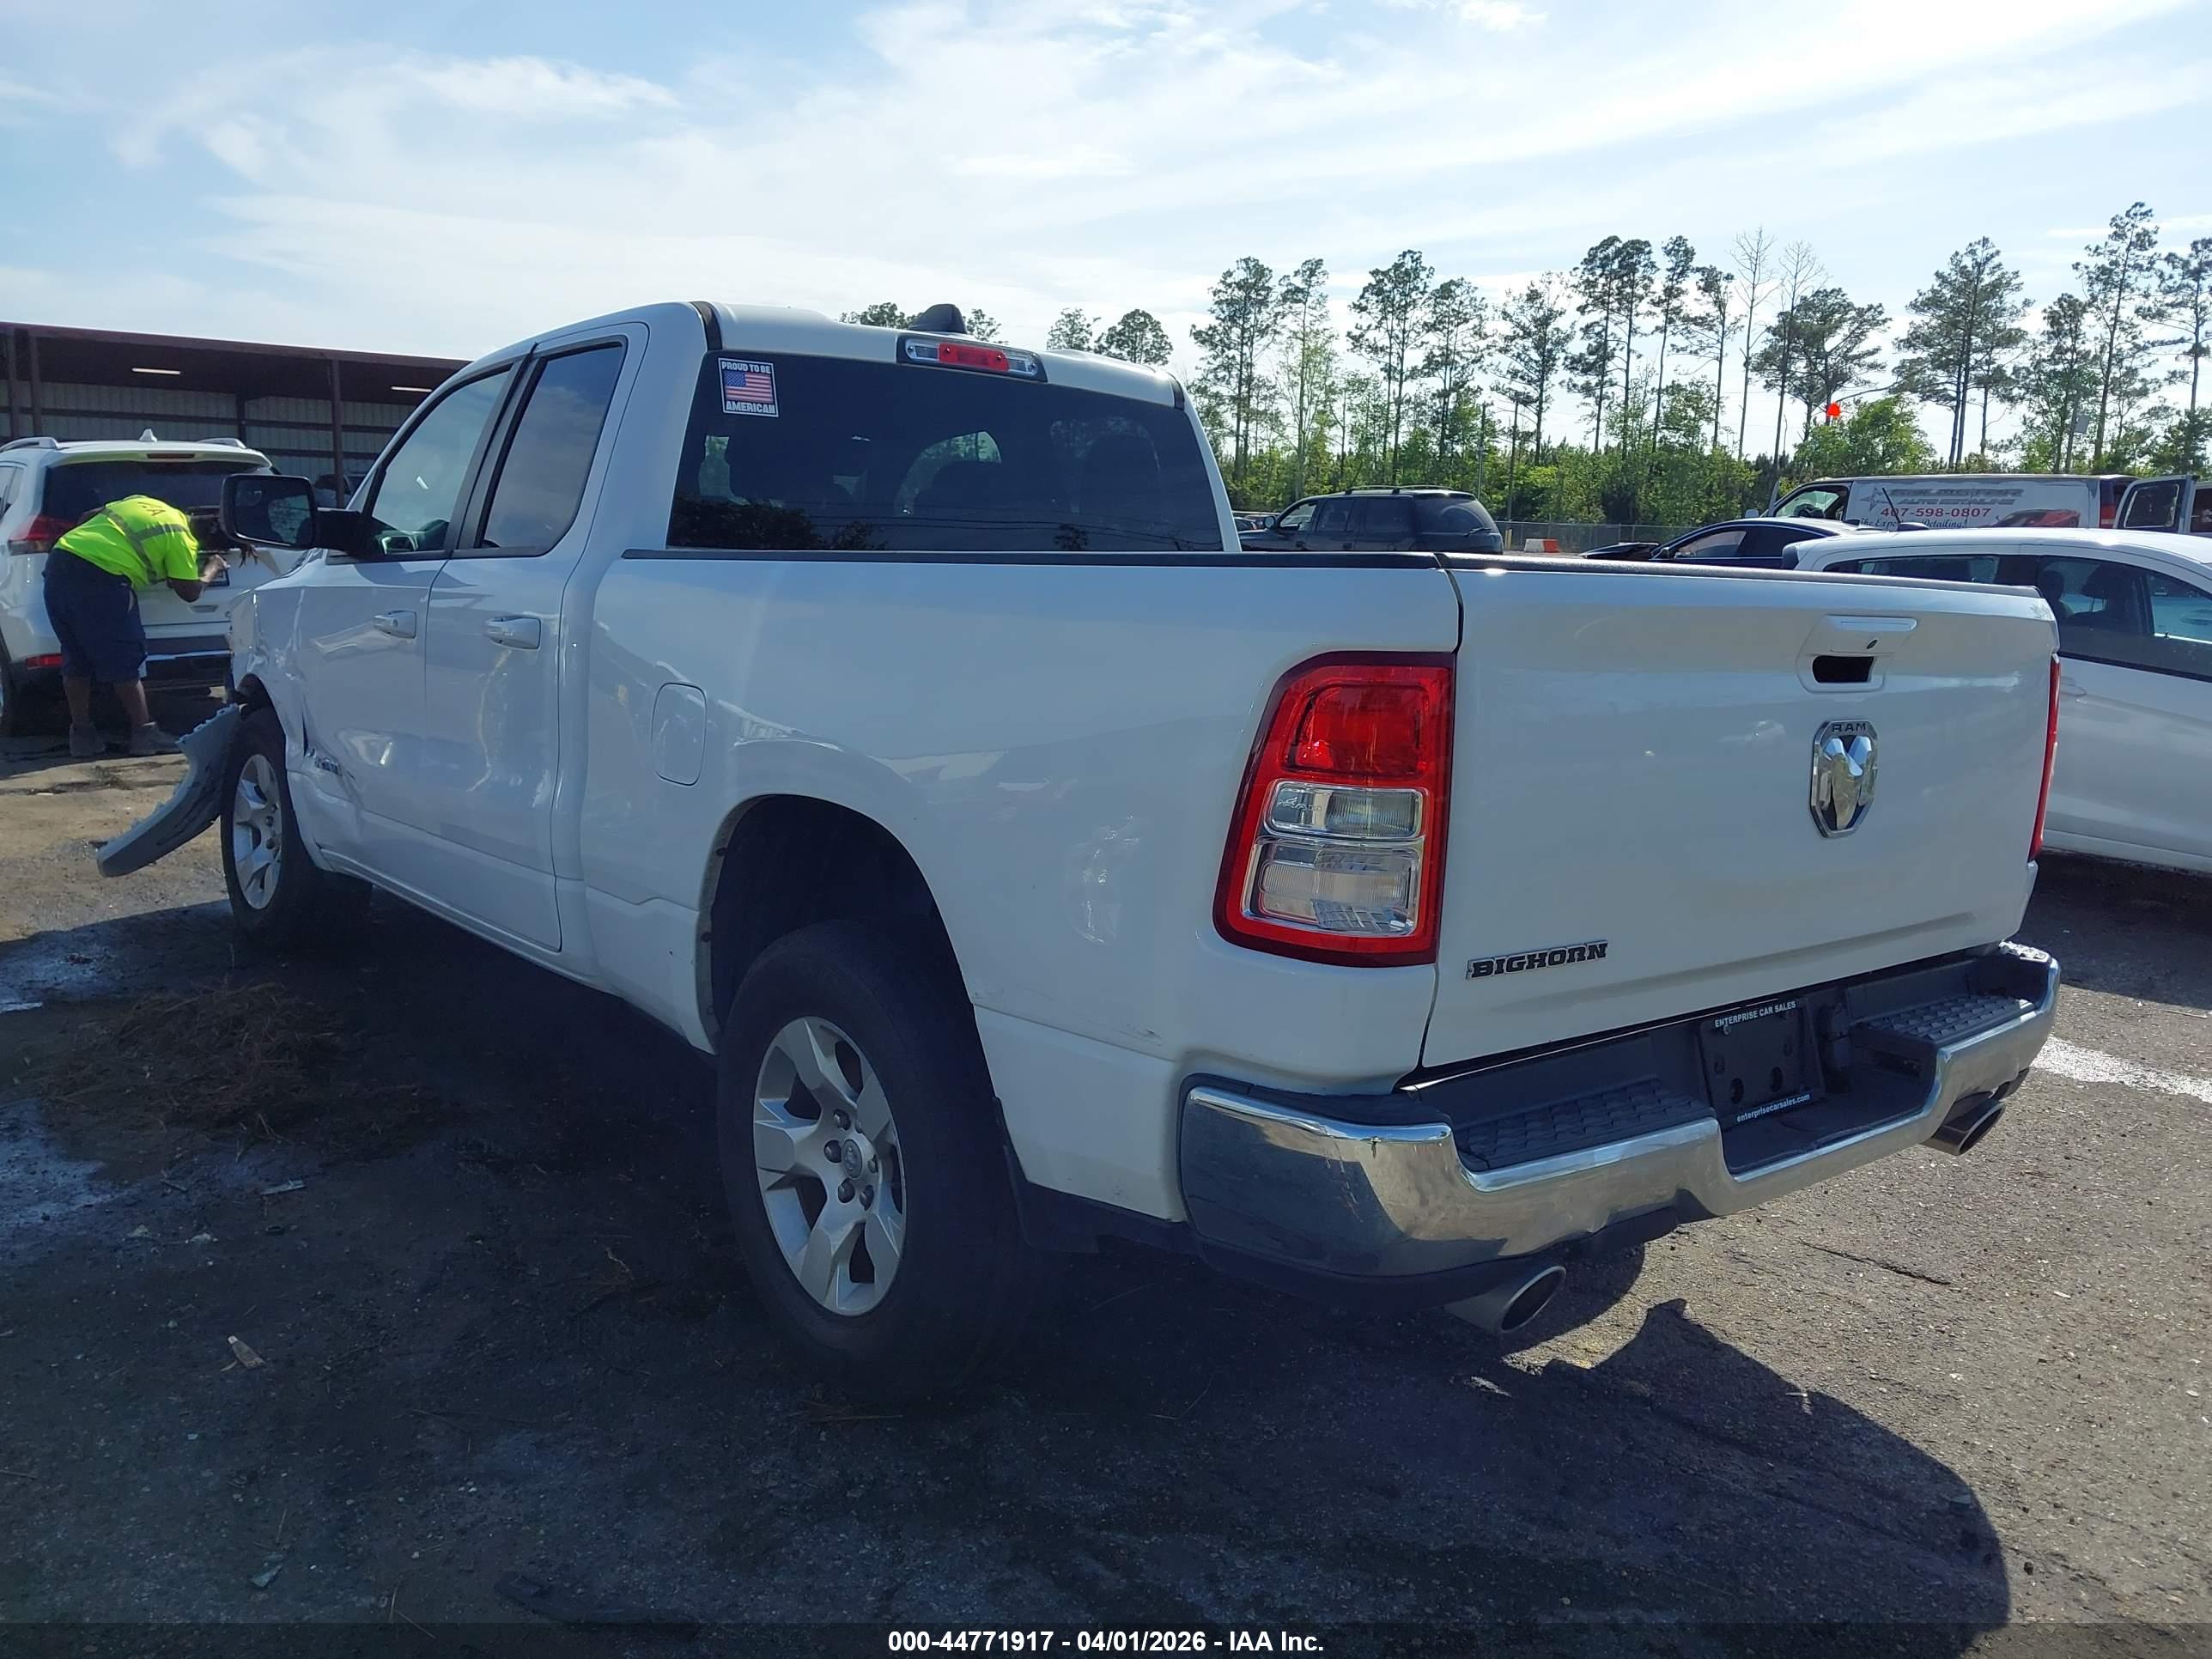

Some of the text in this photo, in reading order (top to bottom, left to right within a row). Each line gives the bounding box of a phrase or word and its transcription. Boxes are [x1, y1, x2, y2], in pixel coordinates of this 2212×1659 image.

[721, 362, 772, 374] PROUD TO BE
[726, 401, 776, 414] AMERICAN
[1881, 507, 1992, 517] 407-598-0807
[1832, 723, 1867, 732] RAM
[1471, 943, 1608, 978] BIGHORN
[1715, 1000, 1796, 1028] ENTERPRISE CAR SALES
[1736, 1093, 1810, 1122] enterprisecarsales.com
